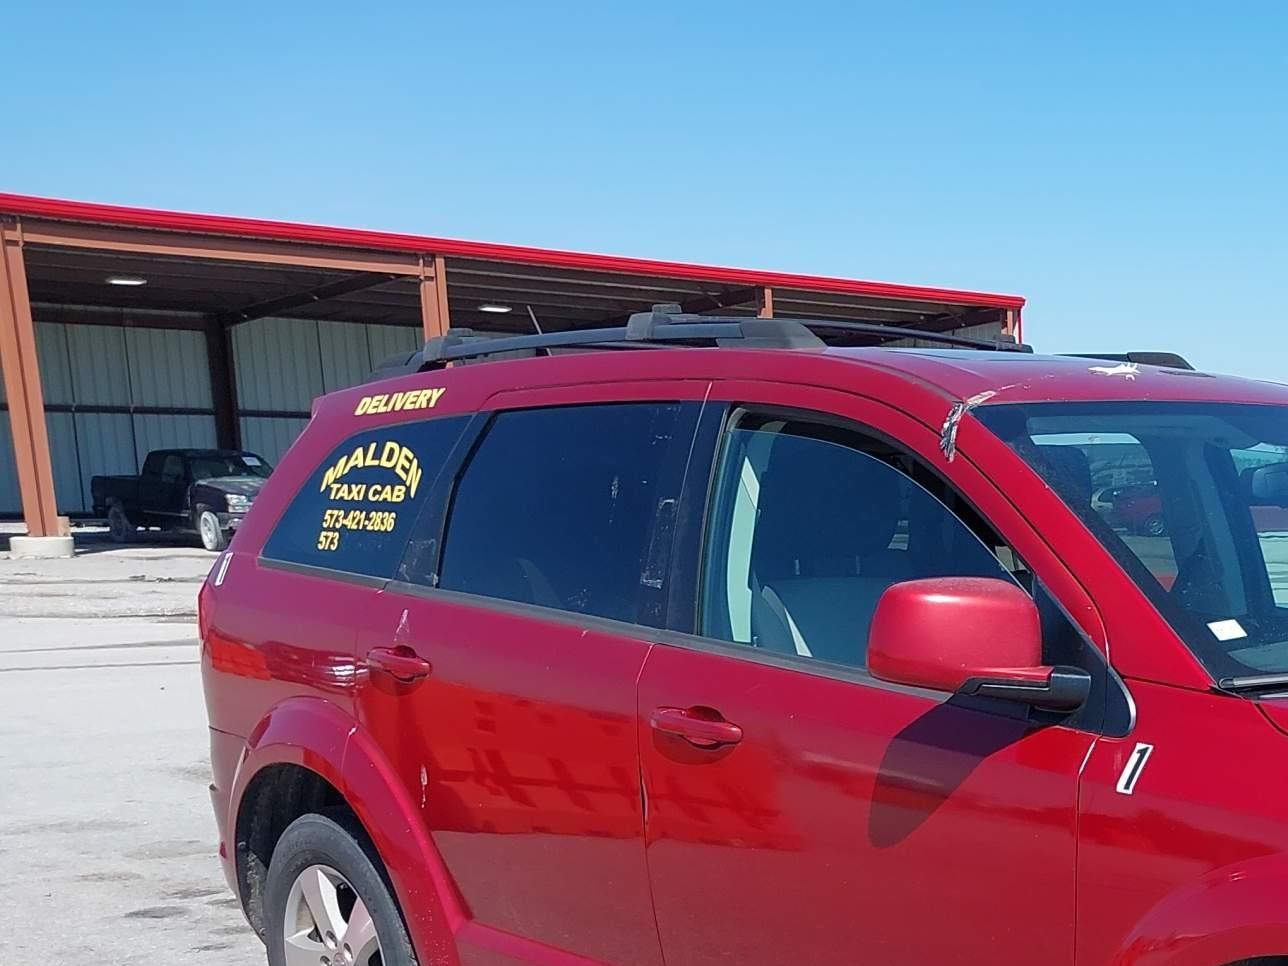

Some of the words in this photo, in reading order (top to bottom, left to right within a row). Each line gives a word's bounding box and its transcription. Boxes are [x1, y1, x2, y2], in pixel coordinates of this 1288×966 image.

[354, 388, 446, 416] DELIVERY
[320, 441, 422, 499] MALDEN
[329, 484, 367, 501] TAXI
[368, 485, 406, 502] CAB
[322, 509, 397, 532] 573-421-2836
[317, 531, 340, 551] 573
